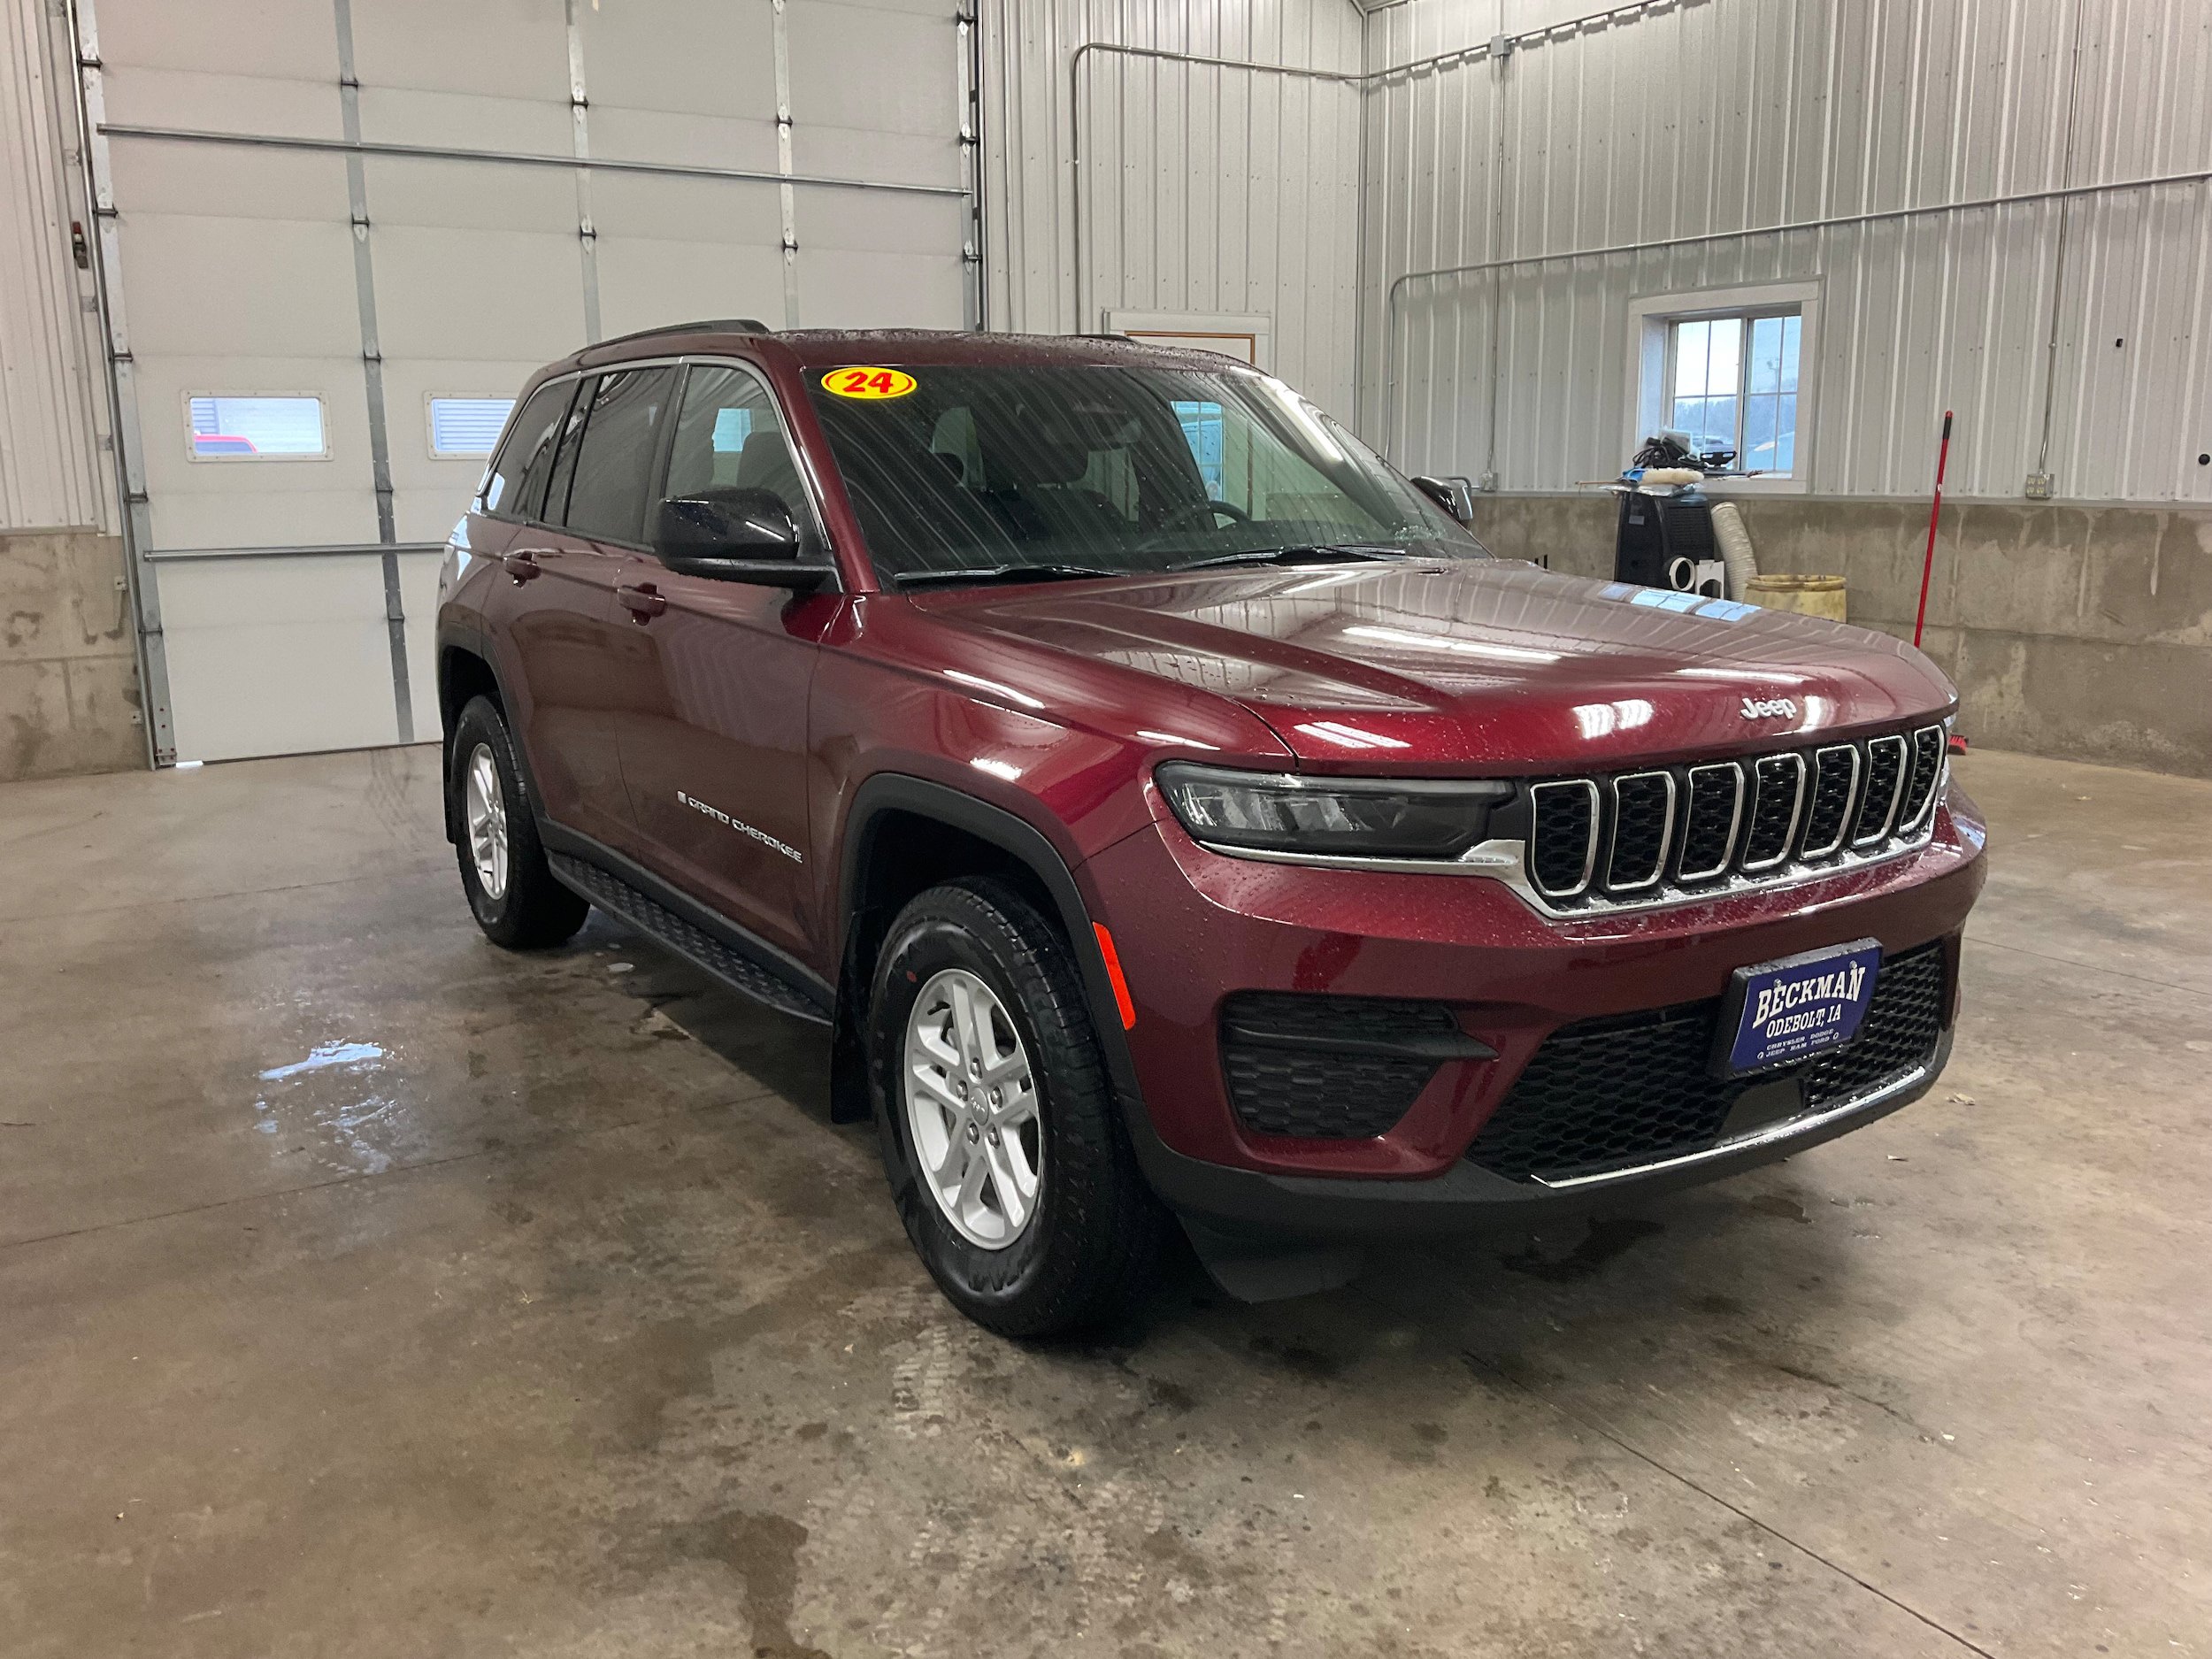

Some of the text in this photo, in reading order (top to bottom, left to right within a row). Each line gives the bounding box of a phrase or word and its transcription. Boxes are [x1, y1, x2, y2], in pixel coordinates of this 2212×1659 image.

[842, 372, 894, 394] 24
[1740, 697, 1797, 720] Jeep
[687, 796, 803, 864] GRAND CHEROKEE
[1752, 967, 1866, 1029] BECKMAN
[1827, 1003, 1841, 1023] IA
[1766, 1028, 1834, 1051] CHRYSLER DODGE
[1766, 1036, 1830, 1057] JEEP RAM FORD
